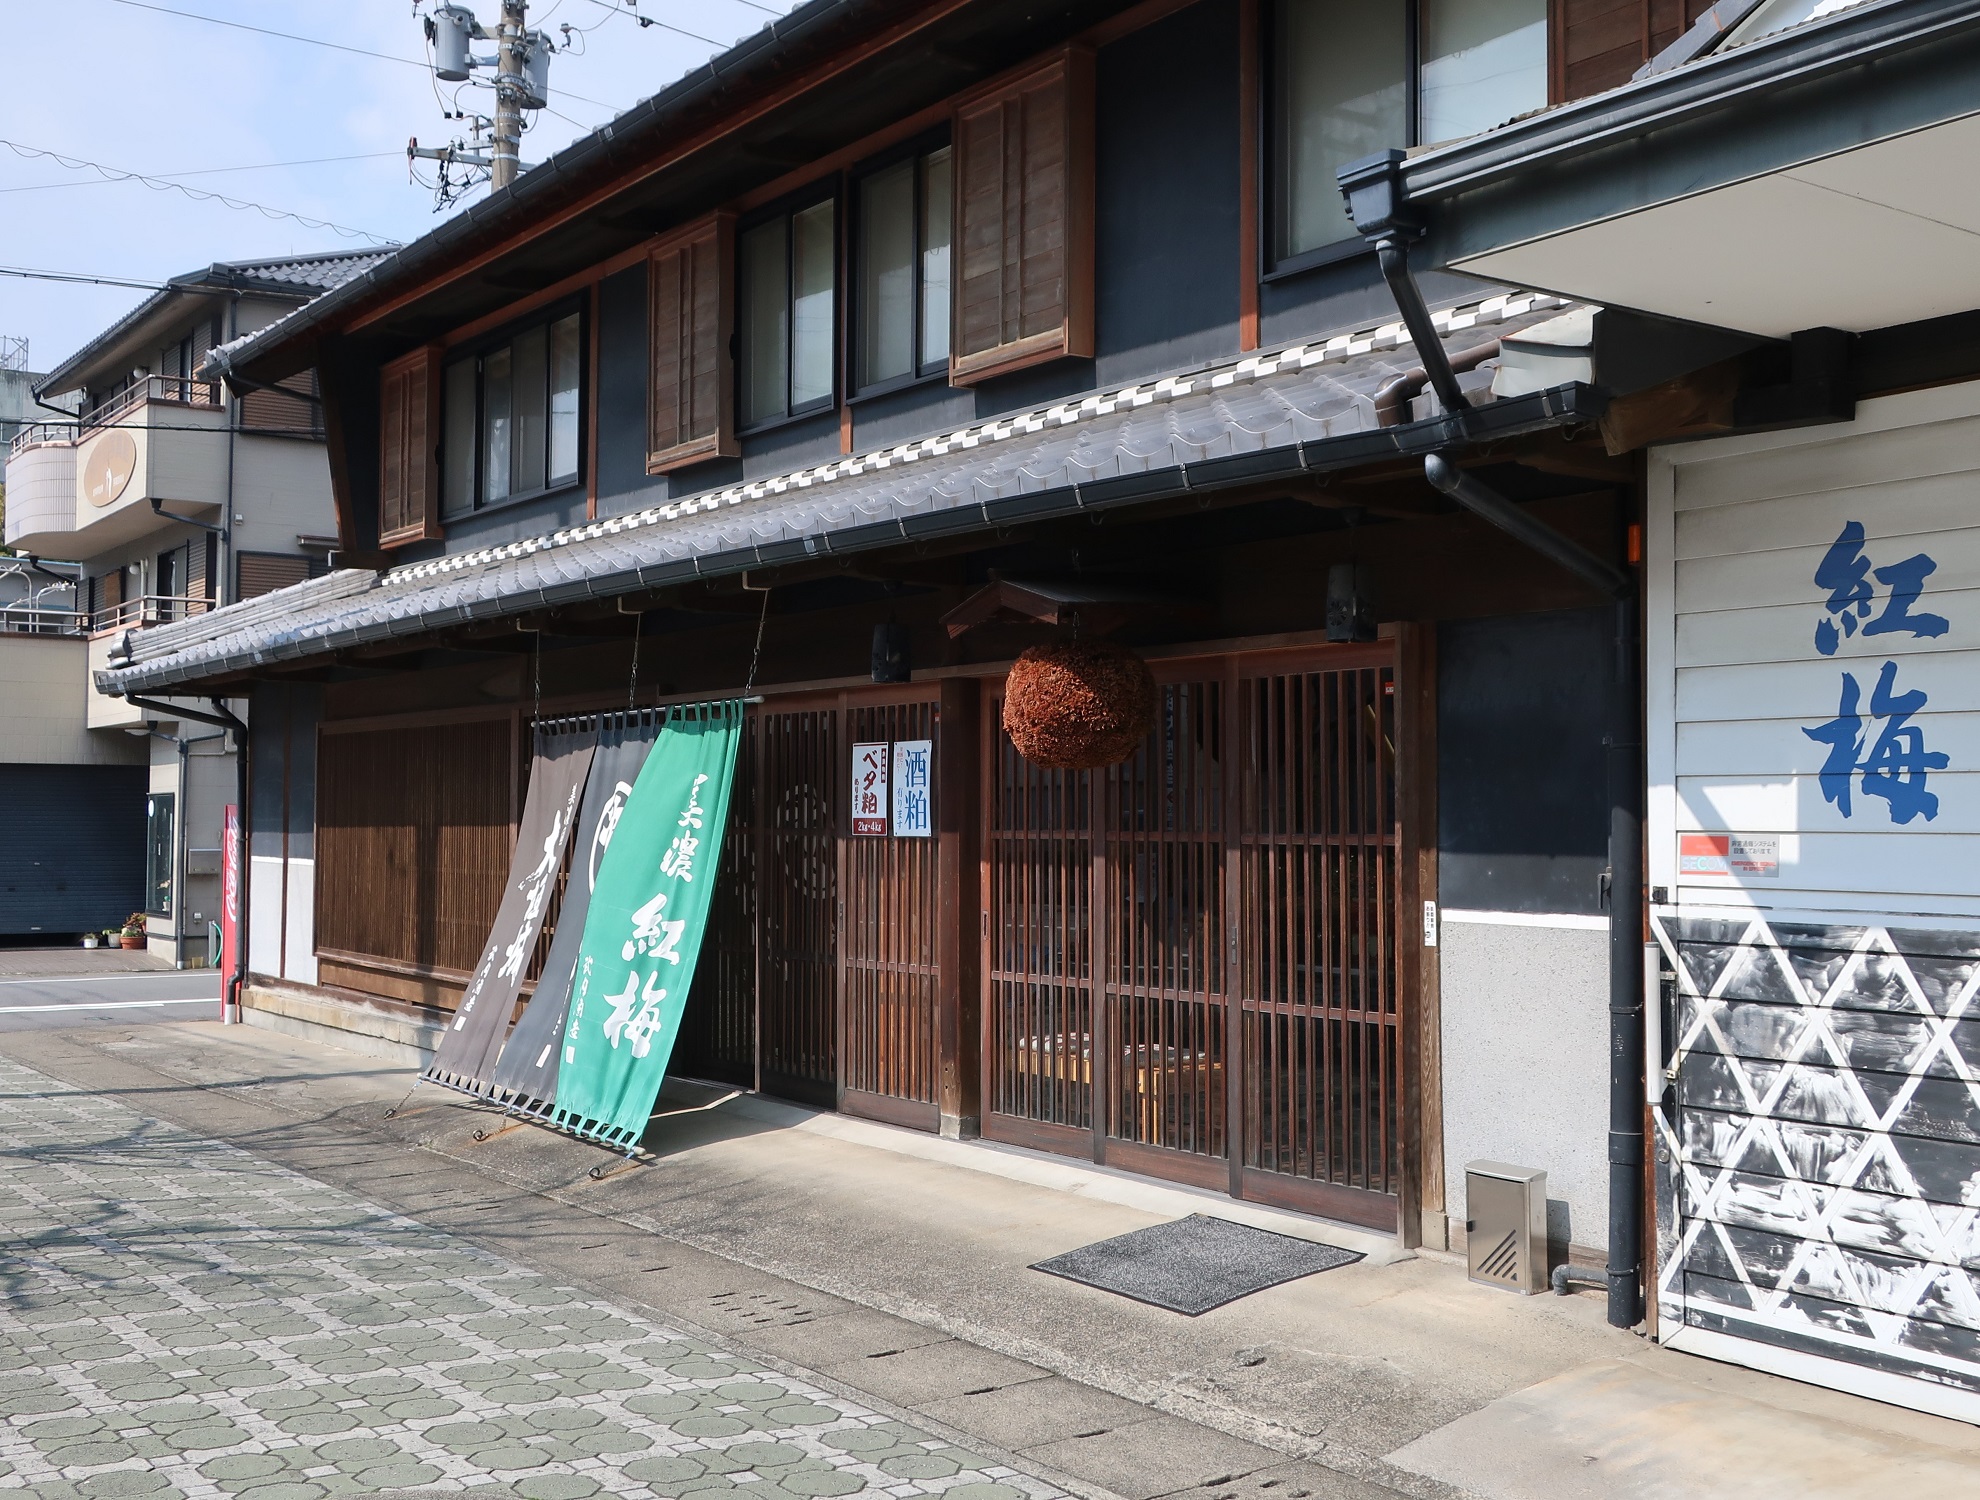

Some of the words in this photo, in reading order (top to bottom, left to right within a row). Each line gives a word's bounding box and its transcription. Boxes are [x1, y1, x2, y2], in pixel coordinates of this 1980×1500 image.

[1801, 520, 1950, 825] 紅梅
[861, 749, 878, 815] ベタ粕
[904, 748, 927, 830] 酒粕
[1682, 857, 1727, 870] SECOM
[603, 893, 686, 1058] 紅梅
